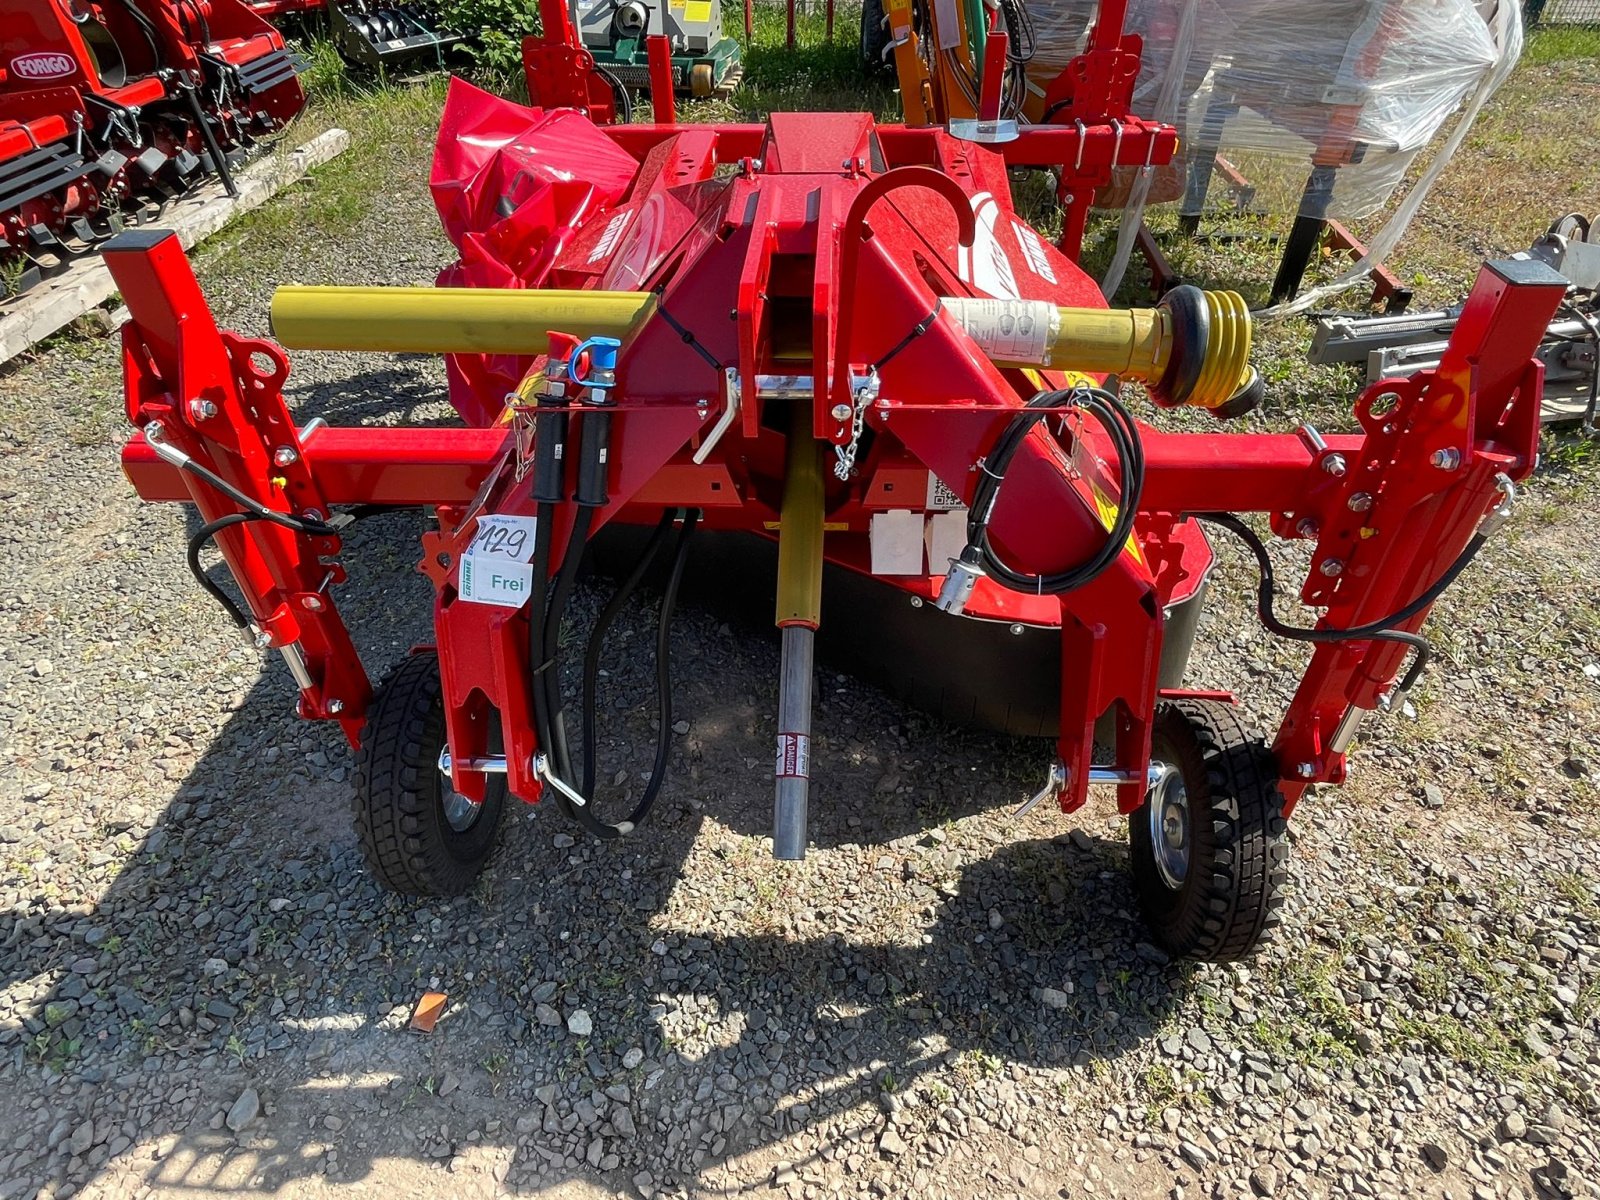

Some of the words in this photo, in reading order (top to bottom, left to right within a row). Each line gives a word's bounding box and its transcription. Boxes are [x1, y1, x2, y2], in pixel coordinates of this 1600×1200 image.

[17, 56, 70, 76] FORIGO
[586, 212, 627, 265] GRIMME
[1019, 224, 1058, 285] GRIMME
[479, 524, 527, 558] 129
[464, 560, 472, 597] GRIMME
[491, 574, 524, 592] Frei
[786, 746, 795, 775] DANGER
